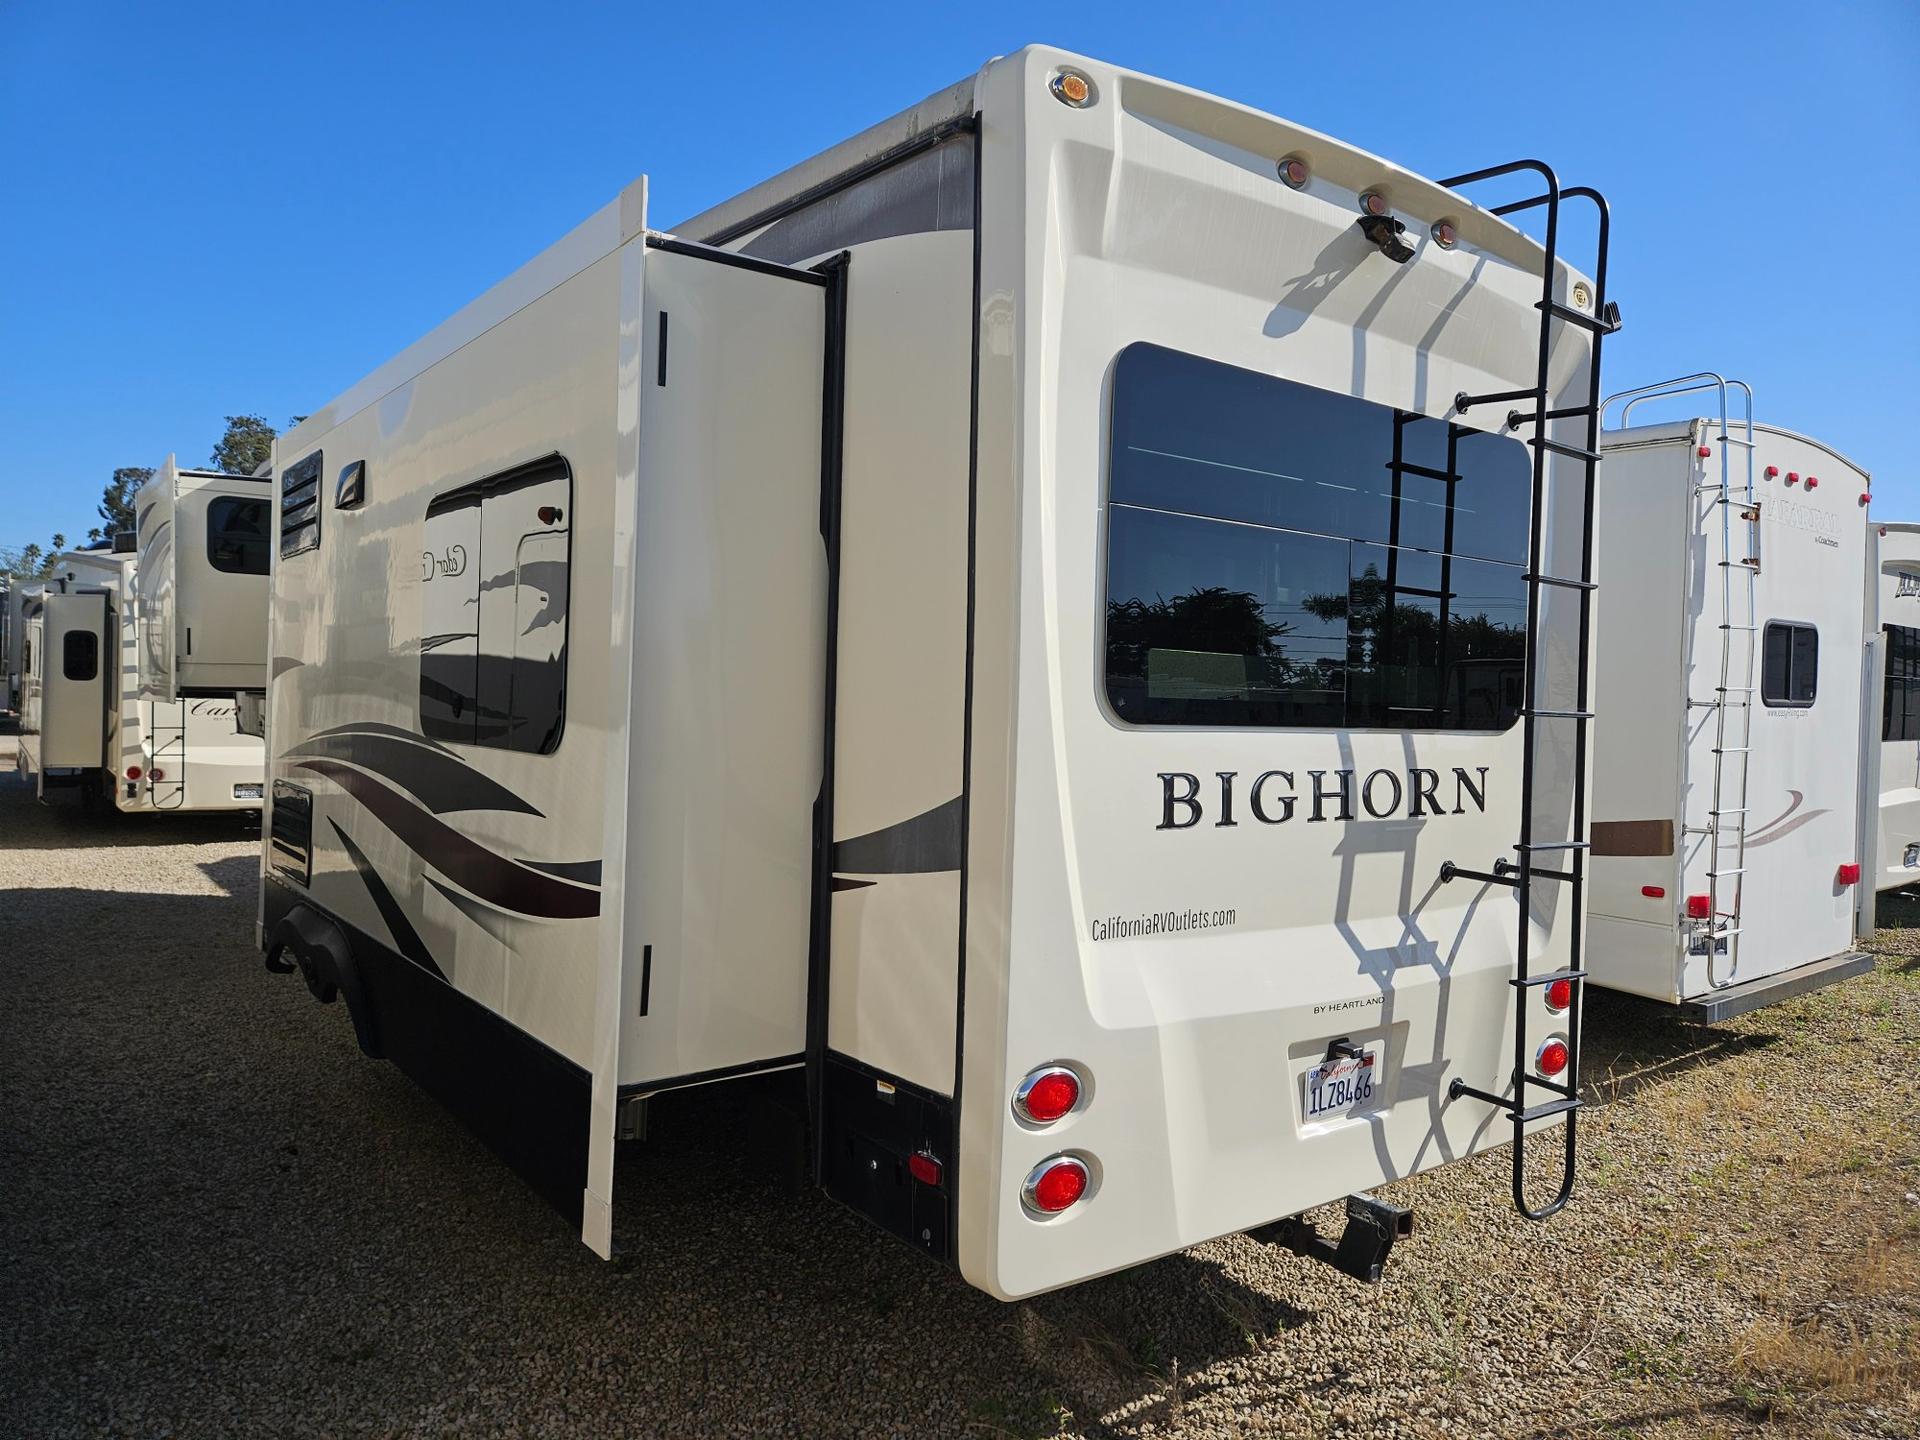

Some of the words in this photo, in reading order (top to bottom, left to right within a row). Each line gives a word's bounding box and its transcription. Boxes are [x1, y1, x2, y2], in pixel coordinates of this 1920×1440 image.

[1156, 767, 1489, 830] BIGHORN
[1092, 908, 1237, 941] CaliforniaRVOutlets.com
[1313, 1005, 1327, 1014] BY
[1329, 996, 1385, 1012] HEARTLAND
[1309, 1072, 1372, 1115] 1LZ8466
